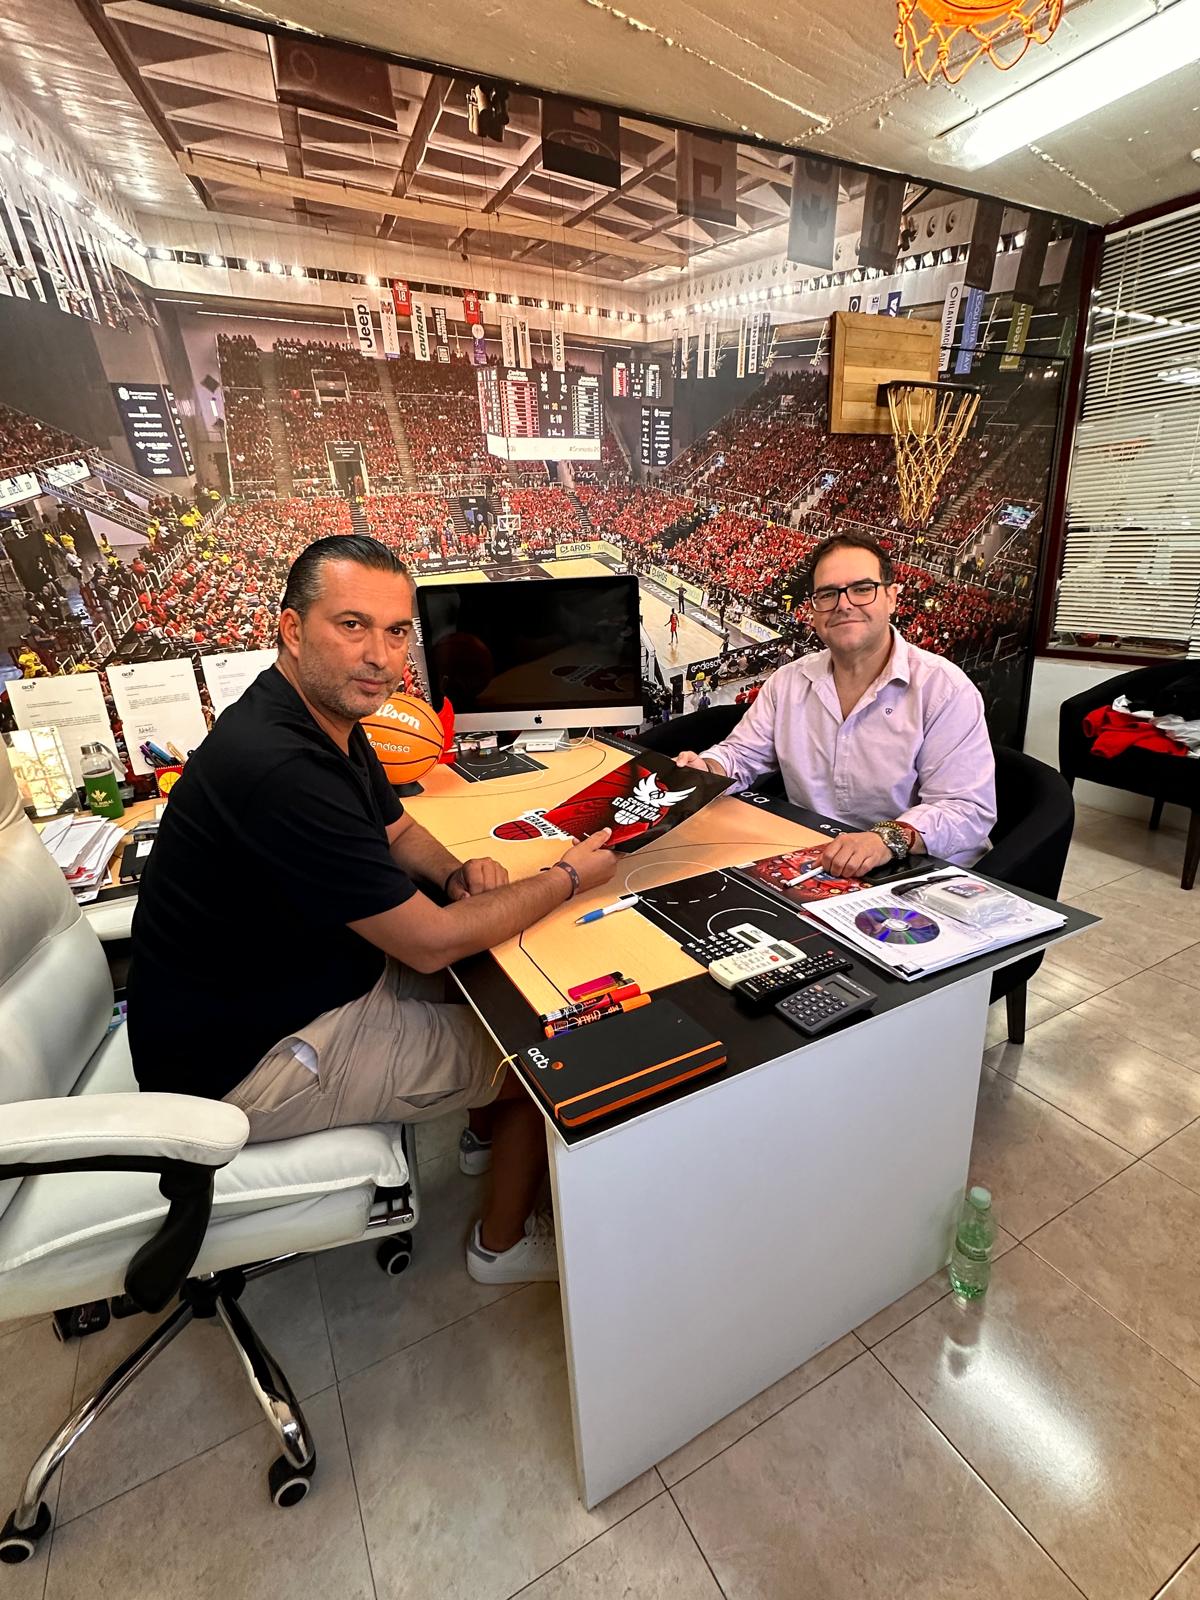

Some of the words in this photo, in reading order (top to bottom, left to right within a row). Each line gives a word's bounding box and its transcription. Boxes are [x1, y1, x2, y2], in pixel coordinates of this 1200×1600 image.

[357, 304, 373, 348] Jeep
[560, 544, 591, 554] CLAROS
[690, 656, 719, 673] endesa
[375, 703, 421, 730] ilson
[369, 740, 410, 753] endesa
[611, 796, 662, 822] GRANADA
[568, 1009, 601, 1027] CHALK
[527, 1047, 550, 1069] acb
